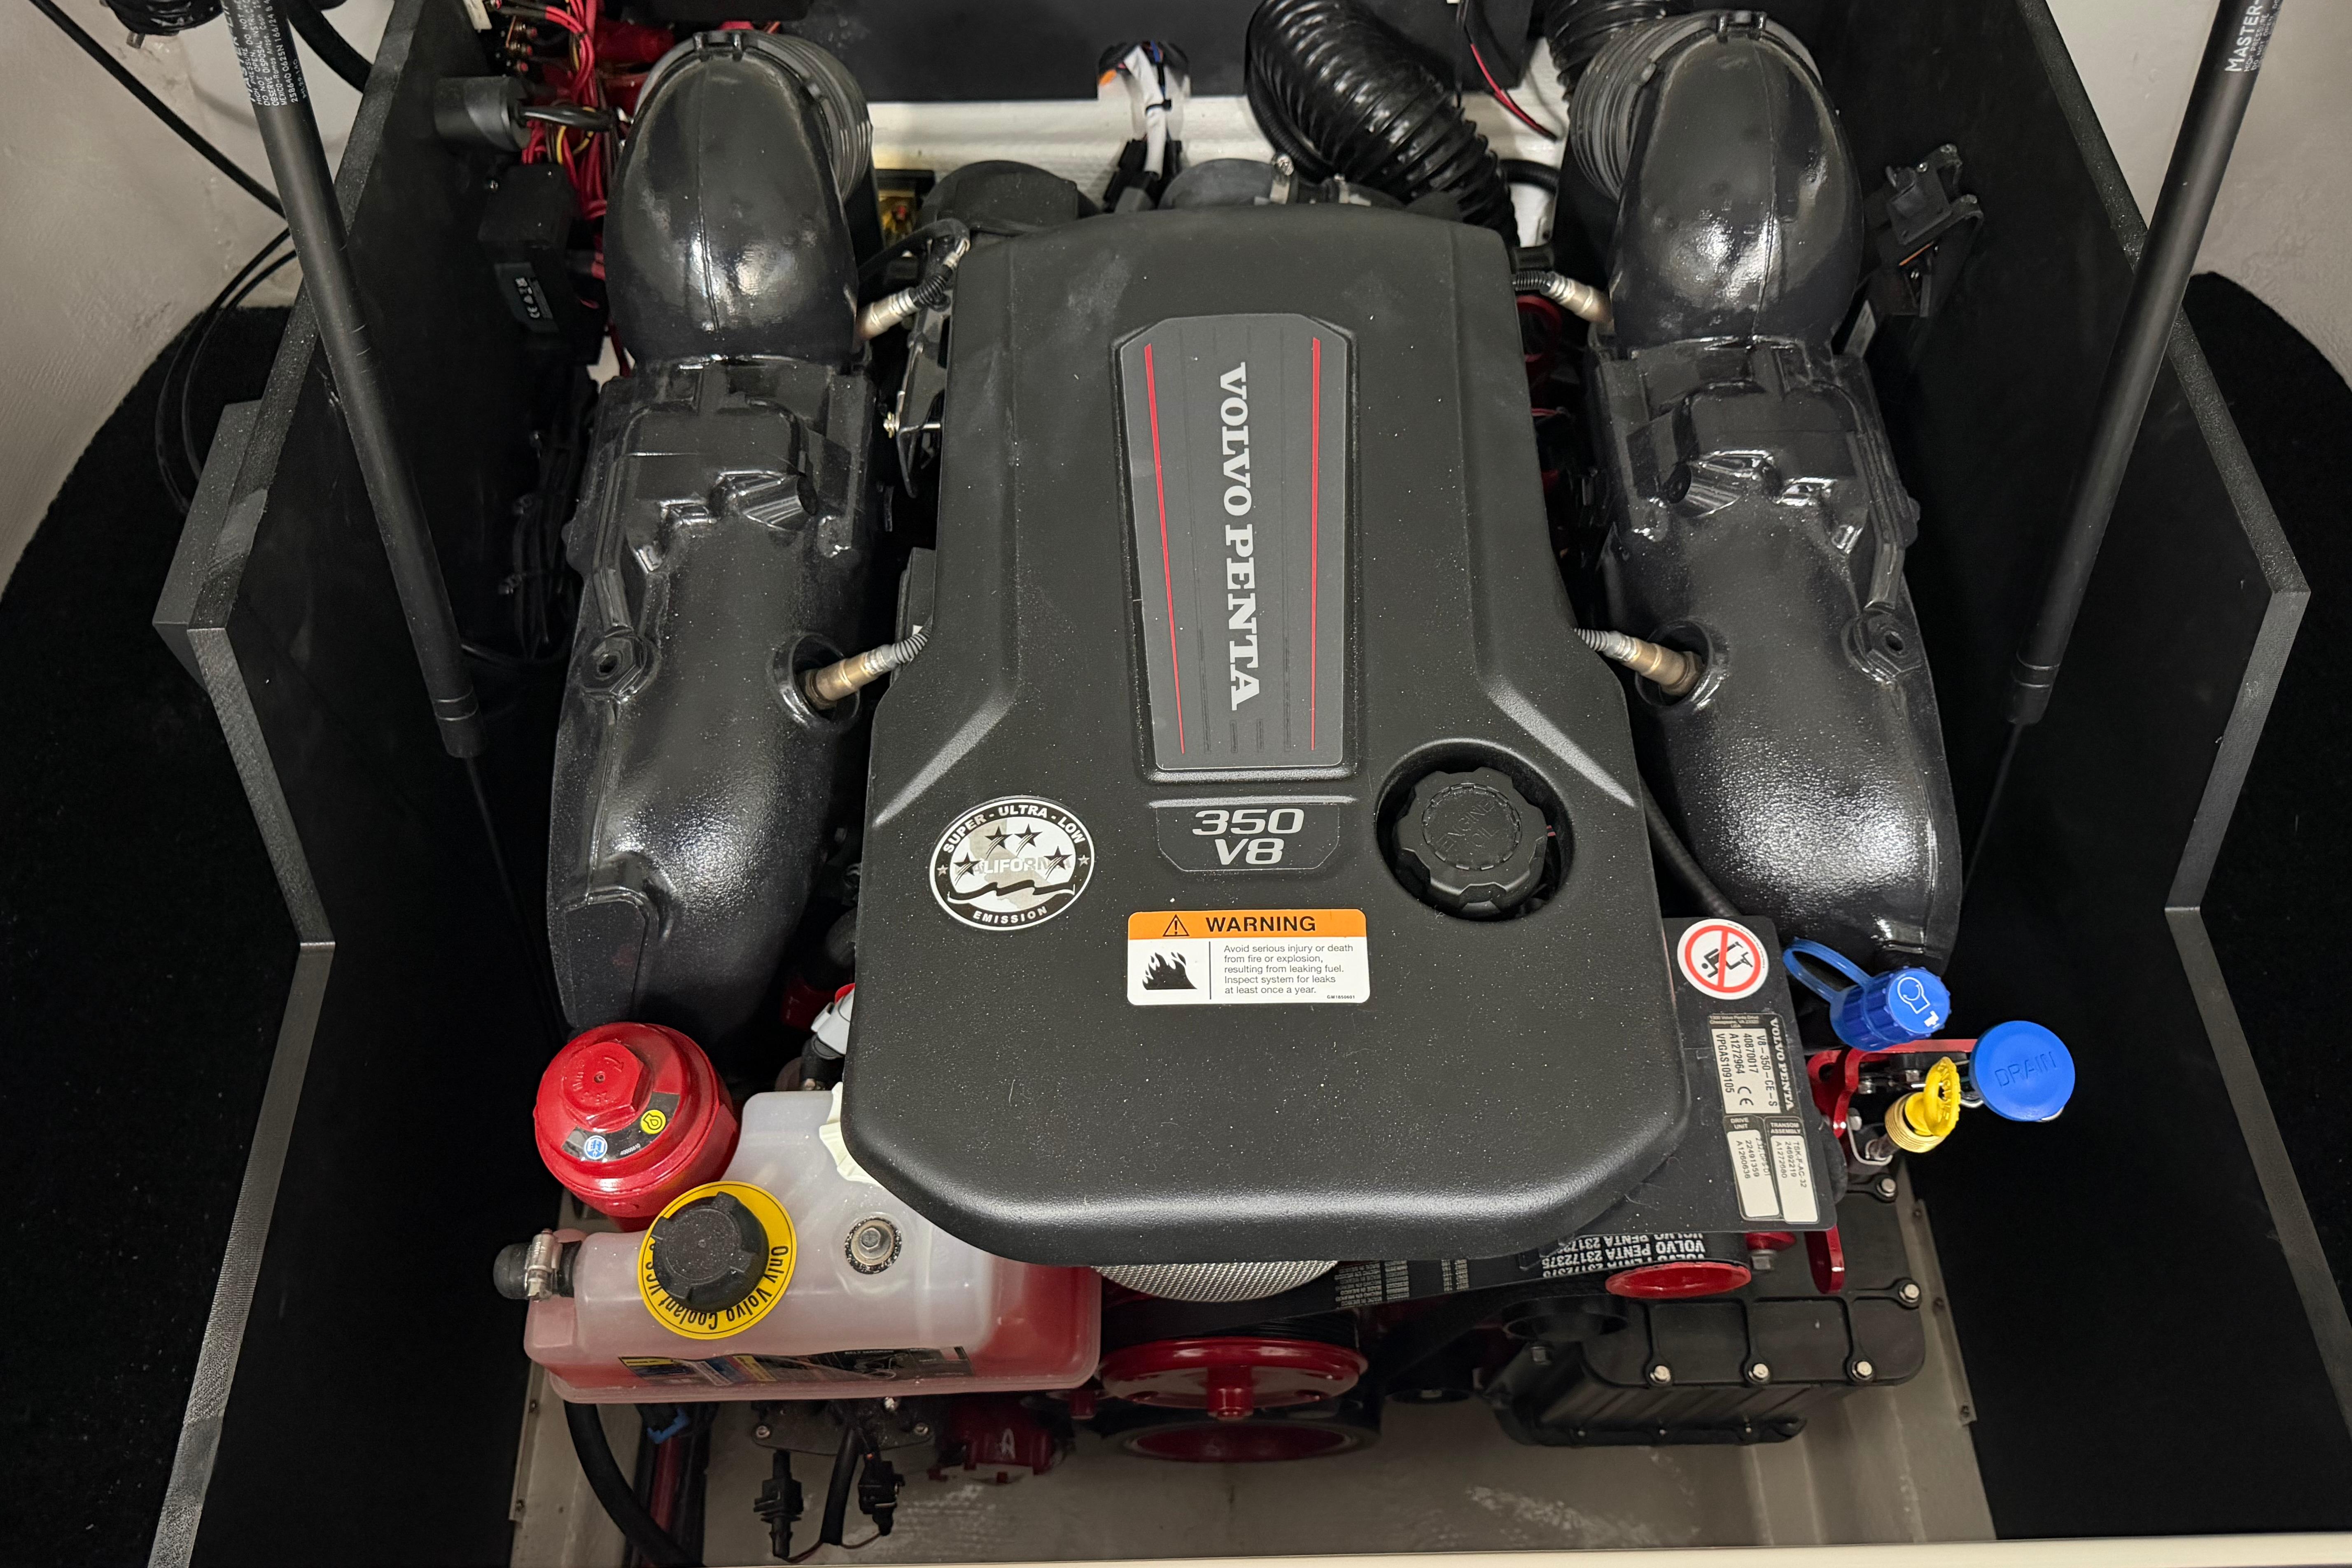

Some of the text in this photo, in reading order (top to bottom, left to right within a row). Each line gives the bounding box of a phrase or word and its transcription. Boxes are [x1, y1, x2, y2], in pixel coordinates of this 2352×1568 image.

[238, 14, 247, 30] NOT
[244, 34, 253, 44] DO
[255, 41, 270, 73] DISPOSAL
[256, 75, 266, 91] NOT
[264, 77, 279, 106] OBSERVE
[262, 95, 270, 106] DO
[1220, 362, 1260, 711] VOLVO PENTA
[943, 814, 987, 854] SUPER
[998, 805, 1048, 818] ULTRA
[1057, 816, 1086, 844] LOW
[1192, 808, 1304, 835] 350
[1436, 800, 1495, 852] ENGINE
[1472, 827, 1499, 847] OIL
[1215, 838, 1284, 865] V8
[973, 906, 1048, 924] EMISSION
[1206, 915, 1316, 932] WARNING
[1224, 944, 1249, 952] Avoid
[1288, 944, 1312, 954] injury
[1276, 954, 1323, 964] explosion,
[1224, 965, 1262, 975] resulting
[1290, 965, 1322, 974] leaking
[1225, 975, 1336, 985] Inspect system for leaks
[1716, 1033, 1735, 1093] VPGAS109105
[1729, 1033, 1745, 1074] A1272964
[1743, 1033, 1759, 1073] 40870017
[1771, 1017, 1794, 1111] VOLVO PENTA
[1995, 1051, 2058, 1087] DRAIN
[1542, 1248, 1603, 1269] 23172375
[1605, 1243, 1652, 1261] PENTA
[1655, 1240, 1705, 1255] VOLVO
[764, 1246, 789, 1283] Only
[658, 1296, 718, 1330] Coolant
[726, 1288, 772, 1322] Volvo
